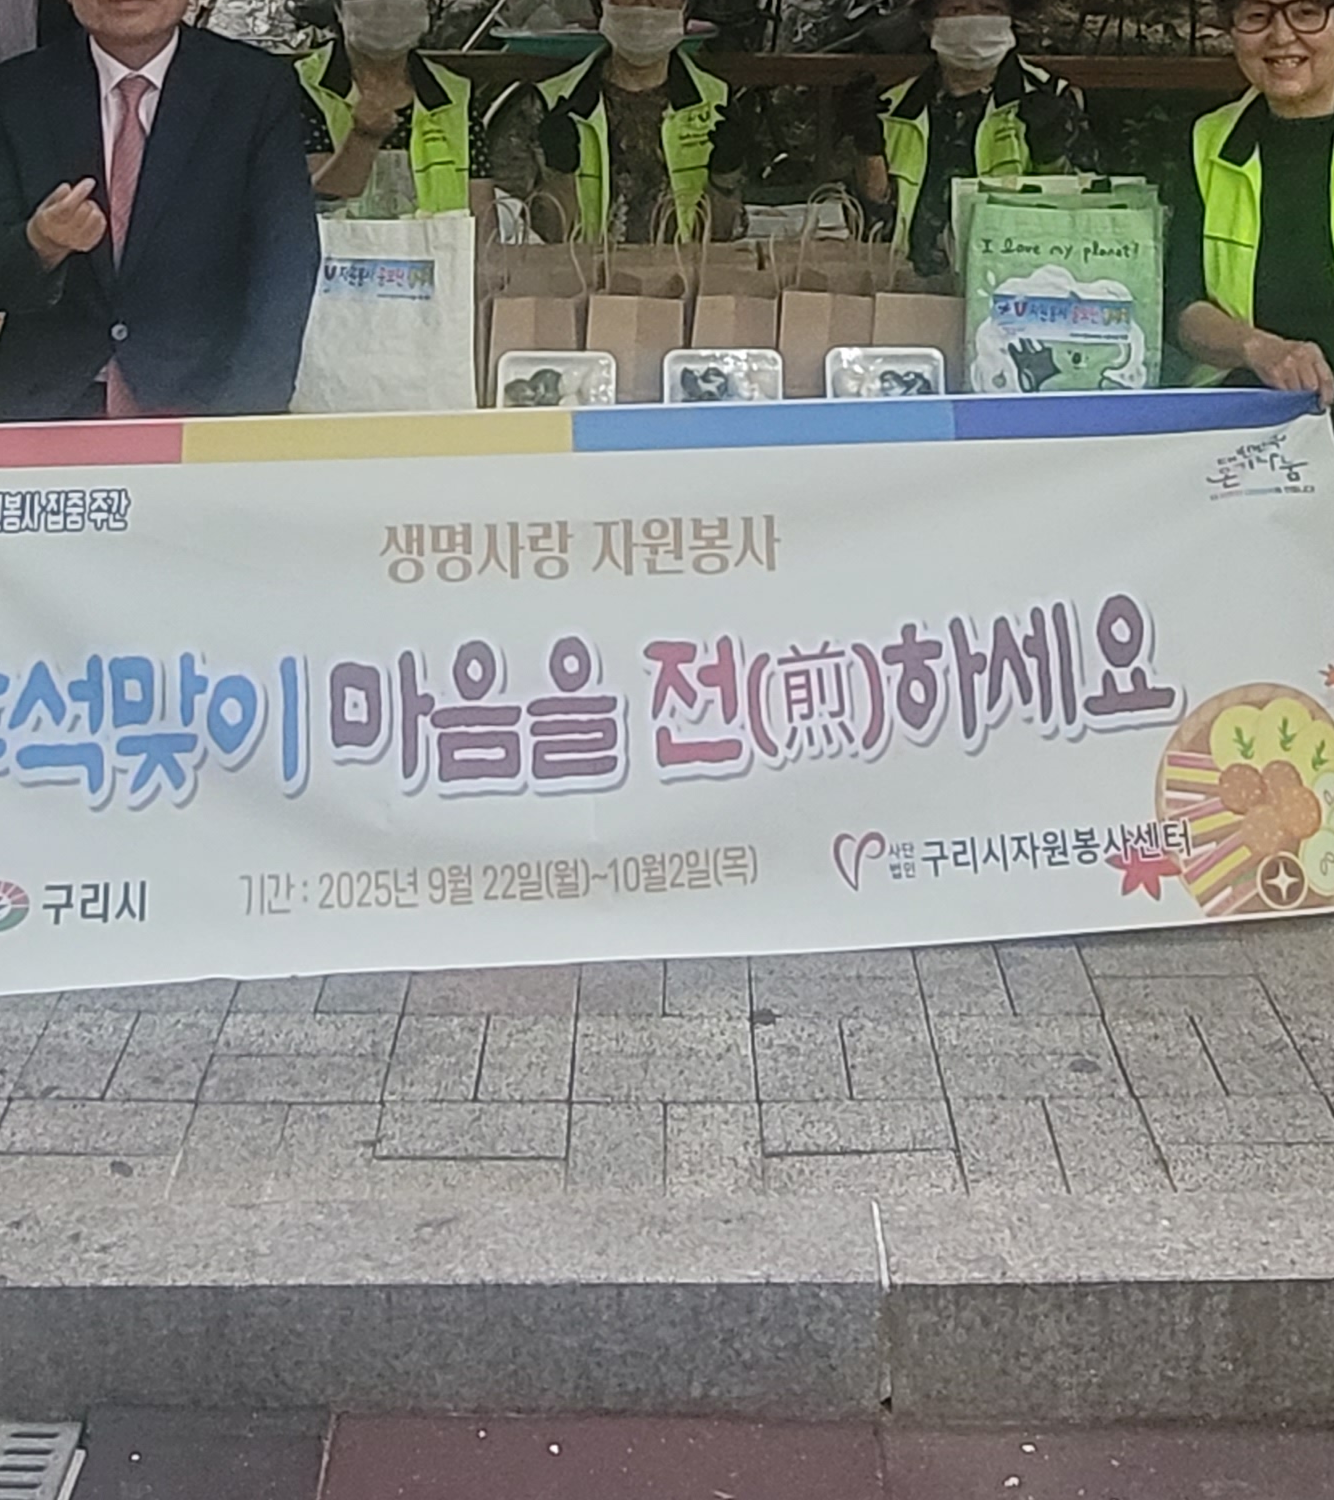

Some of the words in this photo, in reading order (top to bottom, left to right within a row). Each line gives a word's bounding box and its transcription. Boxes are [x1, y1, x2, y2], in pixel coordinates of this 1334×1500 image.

[981, 239, 994, 254] I
[1000, 237, 1041, 255] love
[1049, 244, 1074, 260] my
[43, 490, 86, 532] 집중
[87, 488, 130, 531] 주간
[379, 521, 574, 584] 생명사랑
[591, 514, 781, 576] 자원봉사
[330, 636, 619, 782] 마음을
[887, 843, 916, 861] 사단
[921, 817, 1193, 878] 구리시자원봉사센터
[239, 872, 297, 916] 기간
[317, 869, 420, 910] 2025년
[427, 864, 475, 905] 9월
[888, 862, 917, 880] 법인
[41, 880, 148, 925] 구리시
